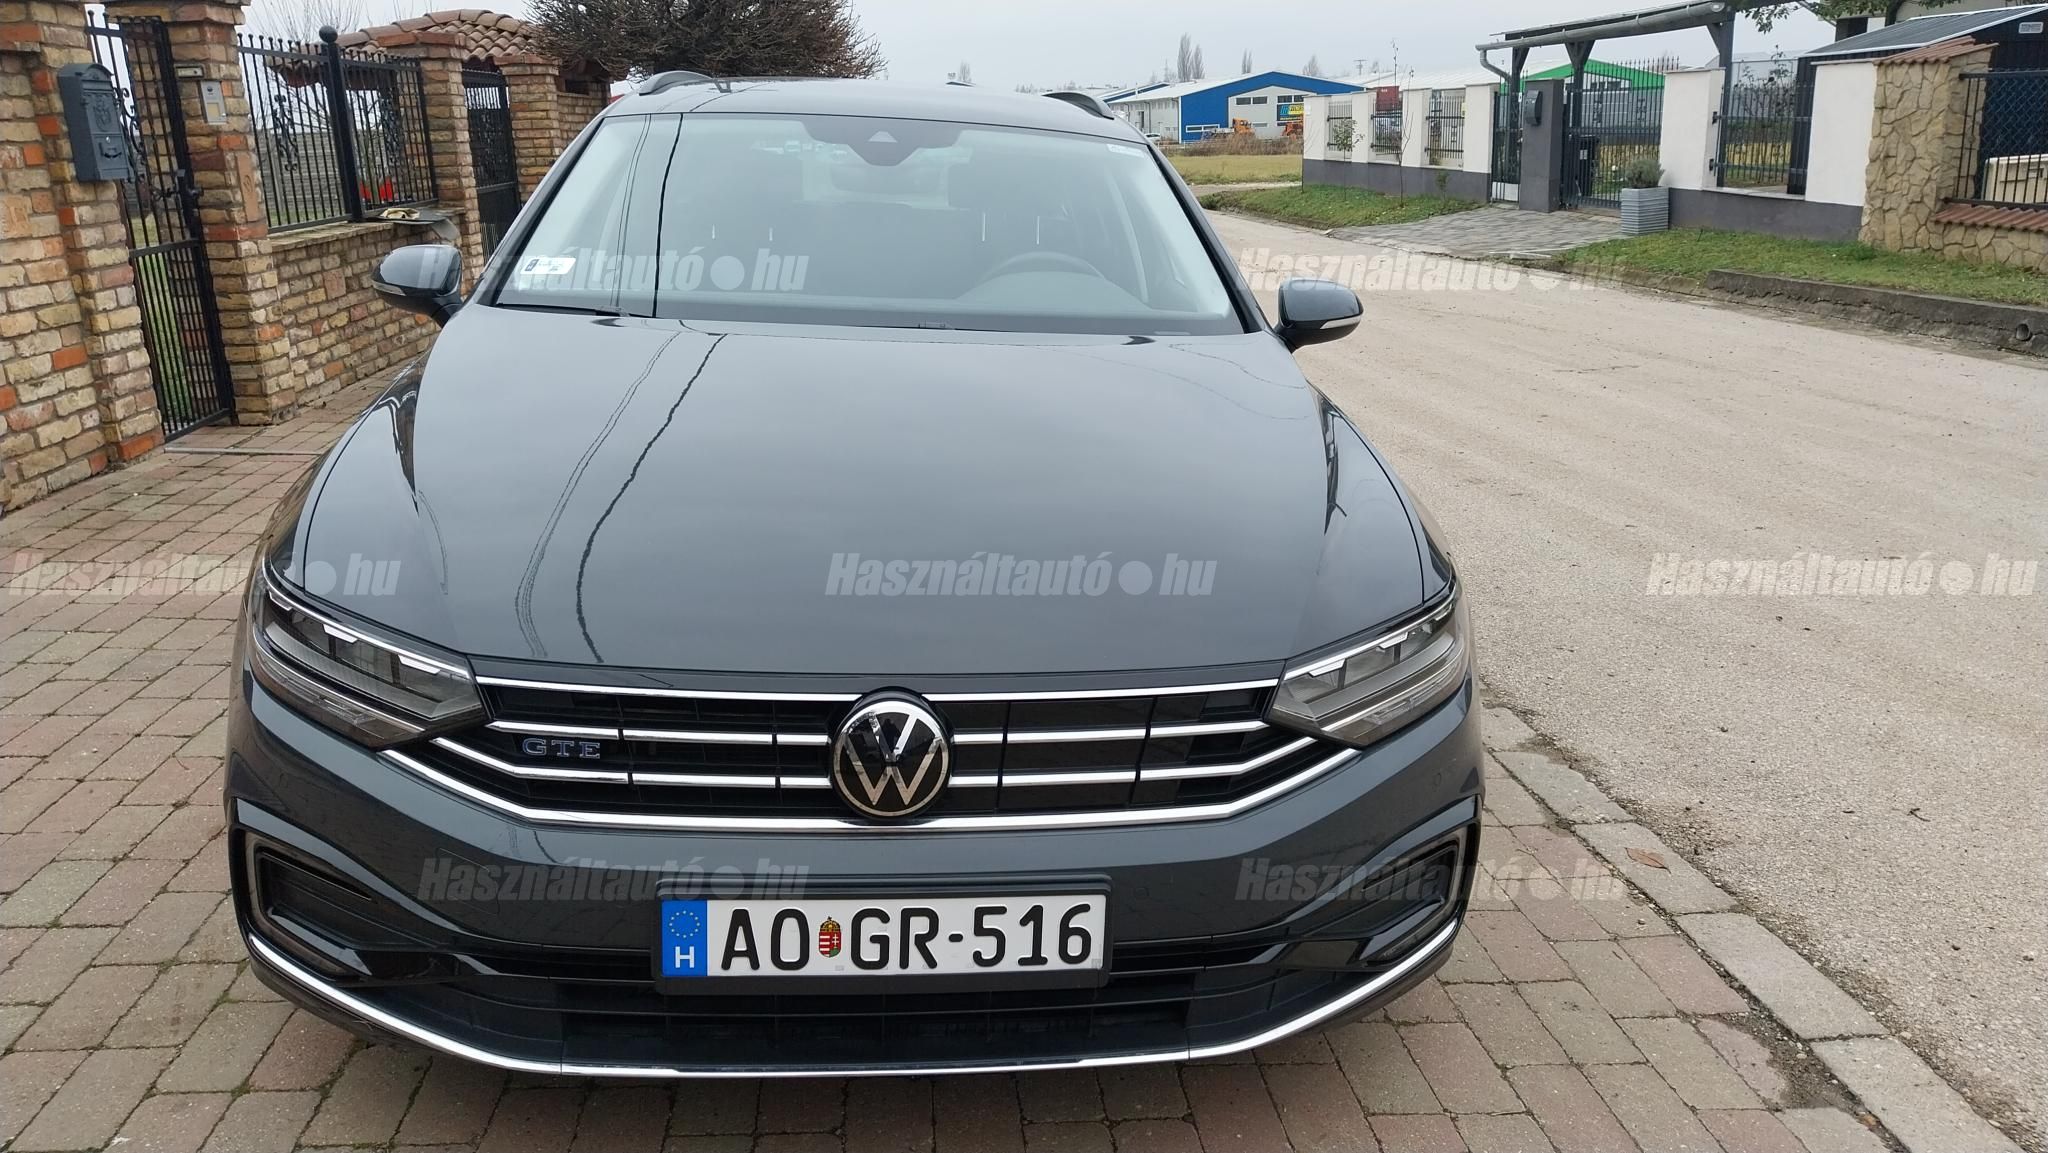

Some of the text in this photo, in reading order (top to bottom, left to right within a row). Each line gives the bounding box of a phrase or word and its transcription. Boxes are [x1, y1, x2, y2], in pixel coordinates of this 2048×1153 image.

[522, 737, 600, 759] GTE
[850, 902, 1091, 970] GR-516
[674, 946, 695, 969] H
